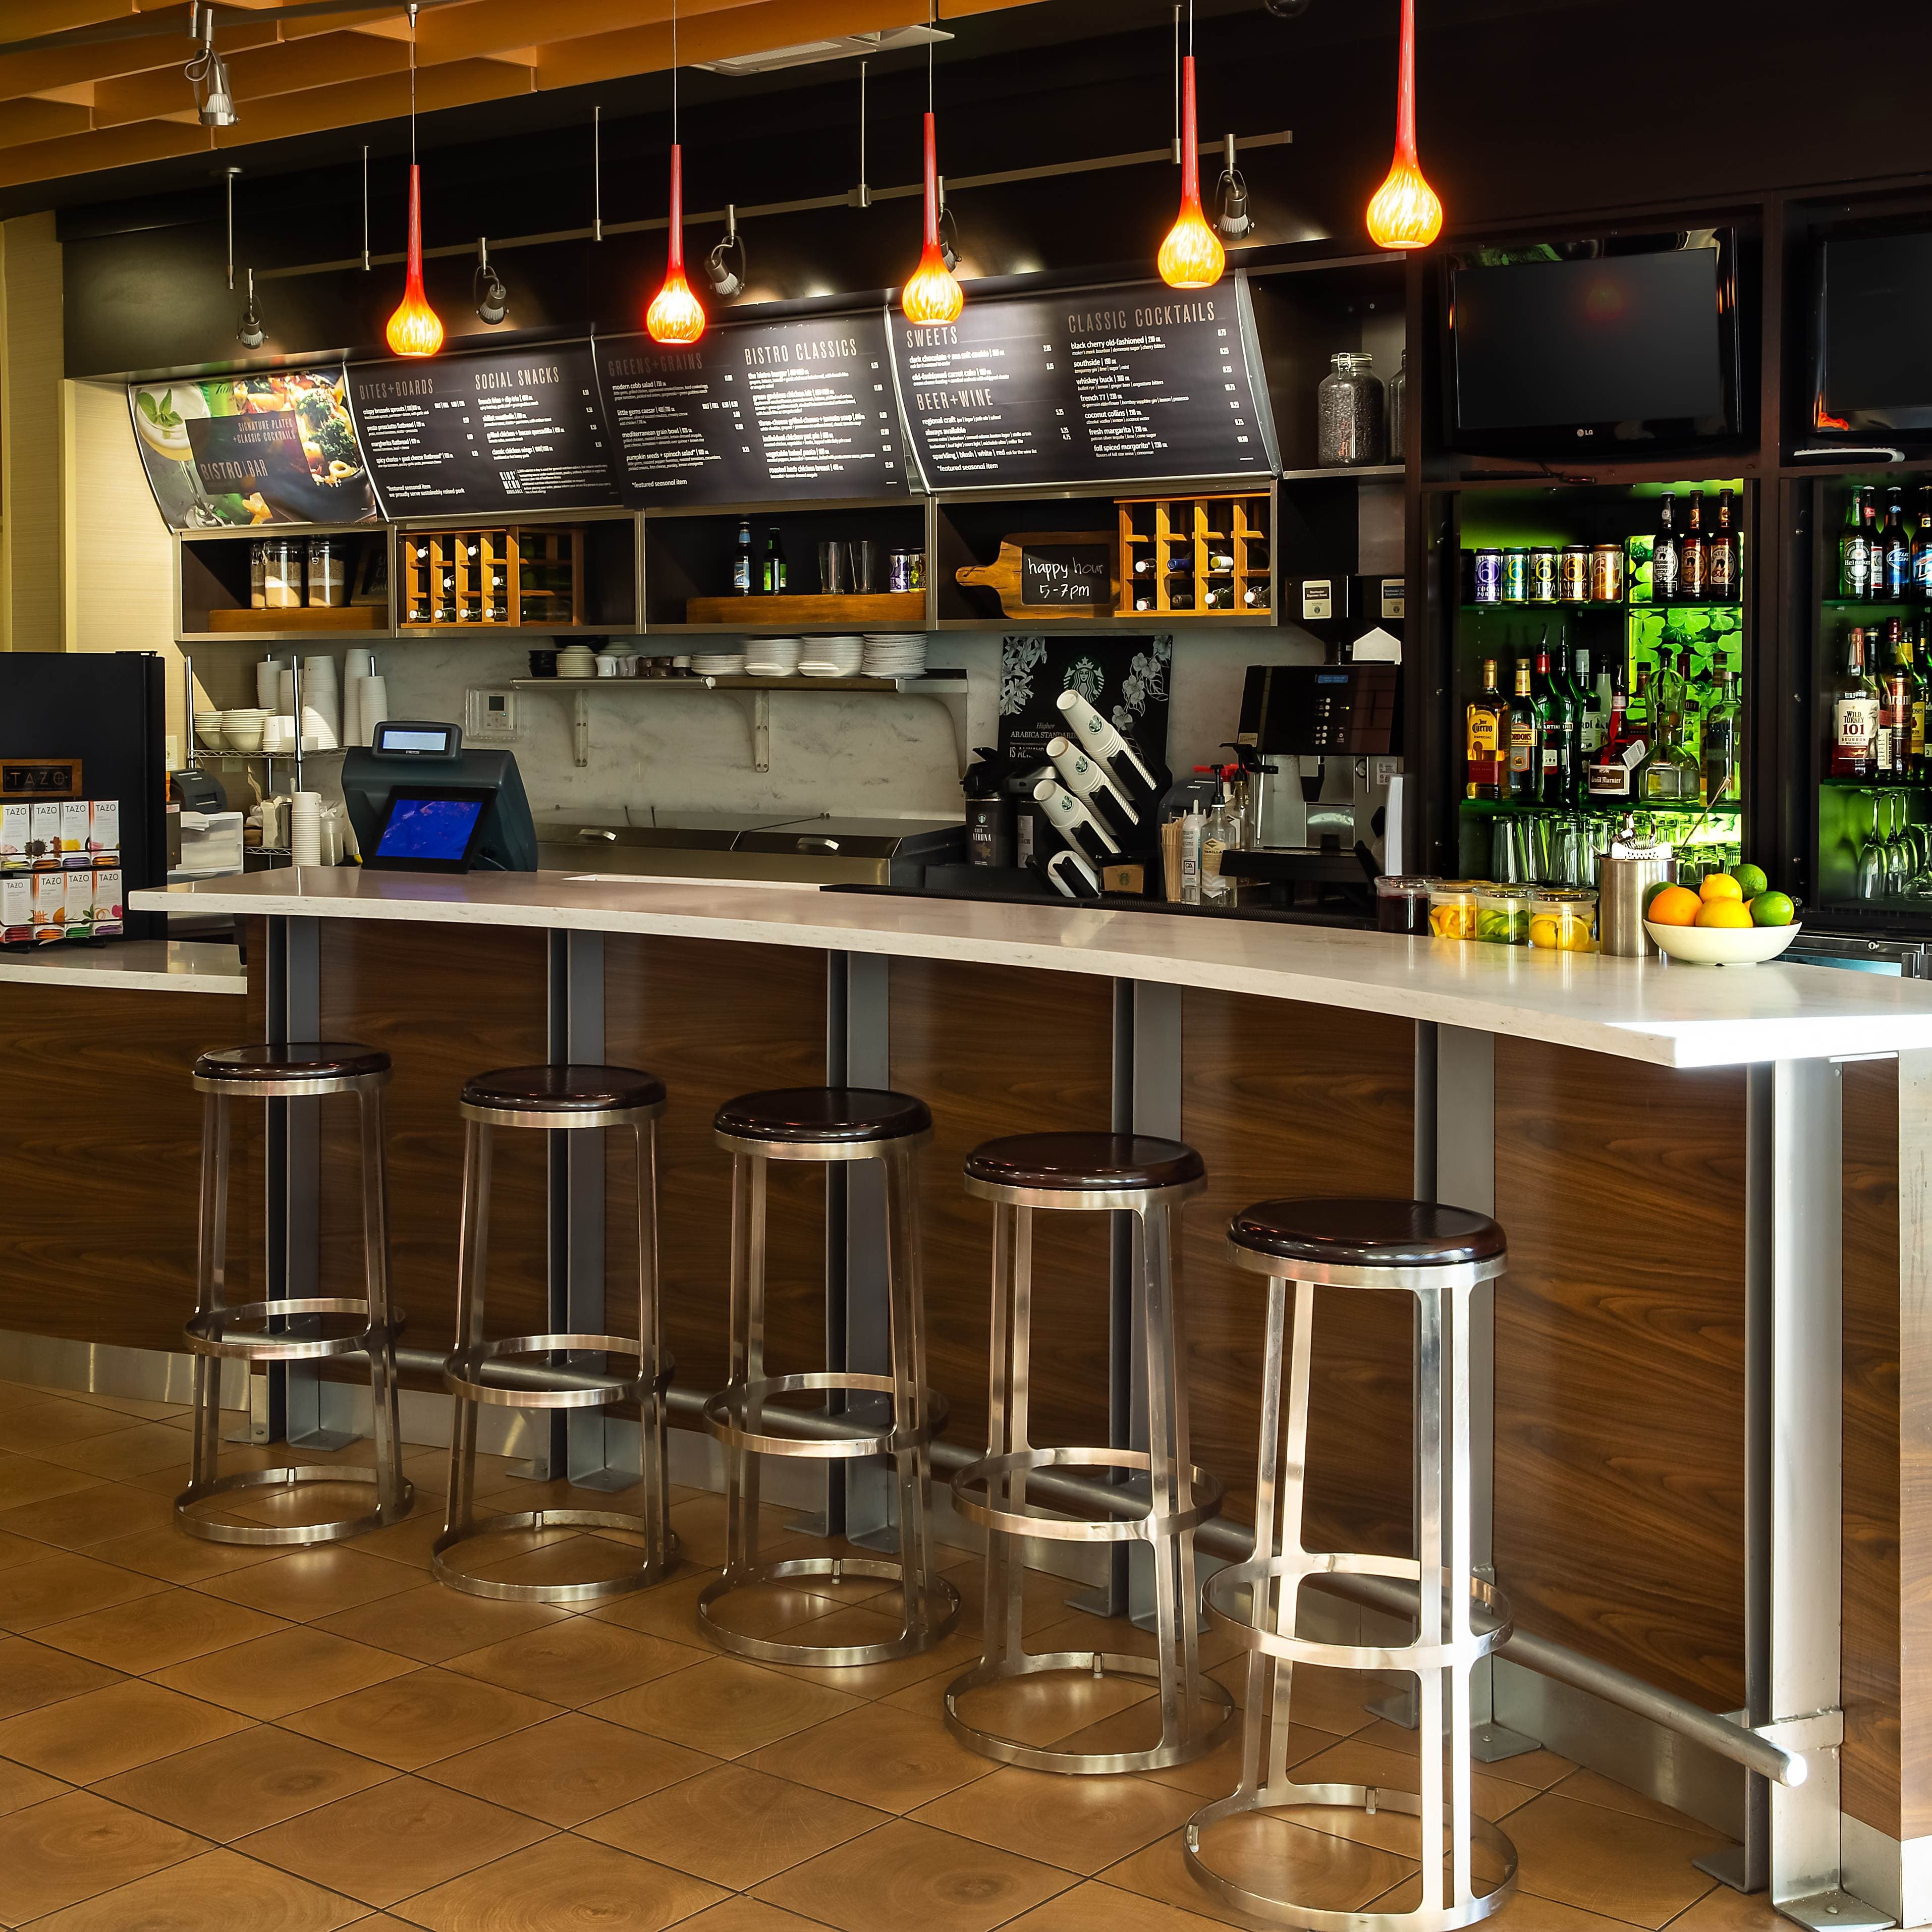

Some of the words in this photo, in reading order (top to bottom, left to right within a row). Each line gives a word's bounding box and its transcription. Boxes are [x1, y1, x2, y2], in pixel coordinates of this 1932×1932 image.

[1068, 310, 1126, 333] CLASSIC
[1135, 301, 1214, 327] COCKTAILS
[906, 326, 958, 348] SWEETS
[1106, 336, 1144, 347] old-fashioned
[744, 345, 788, 365] BISTRO
[795, 339, 857, 360] CLASSICS
[609, 353, 702, 376] GREENS+GRAINS
[1074, 359, 1100, 367] southside
[475, 371, 513, 390] SOCIAL
[518, 367, 559, 386] SNACKS
[1076, 377, 1098, 385] whiskey
[359, 379, 433, 400] BITES+BOARDS
[916, 389, 994, 410] BEER+WINE
[1080, 394, 1098, 402] french
[238, 420, 269, 432] SIGNATURE
[271, 418, 293, 429] PLATES
[922, 417, 943, 426] regional
[233, 433, 261, 444] +CLASSIC
[263, 430, 295, 442] COCKTAILS
[1104, 426, 1131, 435] margarita
[932, 452, 956, 460] sparkling
[201, 461, 243, 480] BISTRO
[246, 459, 268, 477] BAR
[503, 480, 520, 489] MENU
[1028, 558, 1068, 581] happy
[1073, 557, 1103, 574] hour
[1040, 584, 1090, 600] 5-7pm
[1472, 723, 1492, 733] Cuervo
[1843, 724, 1865, 735] 101
[10, 772, 65, 785] TAZO
